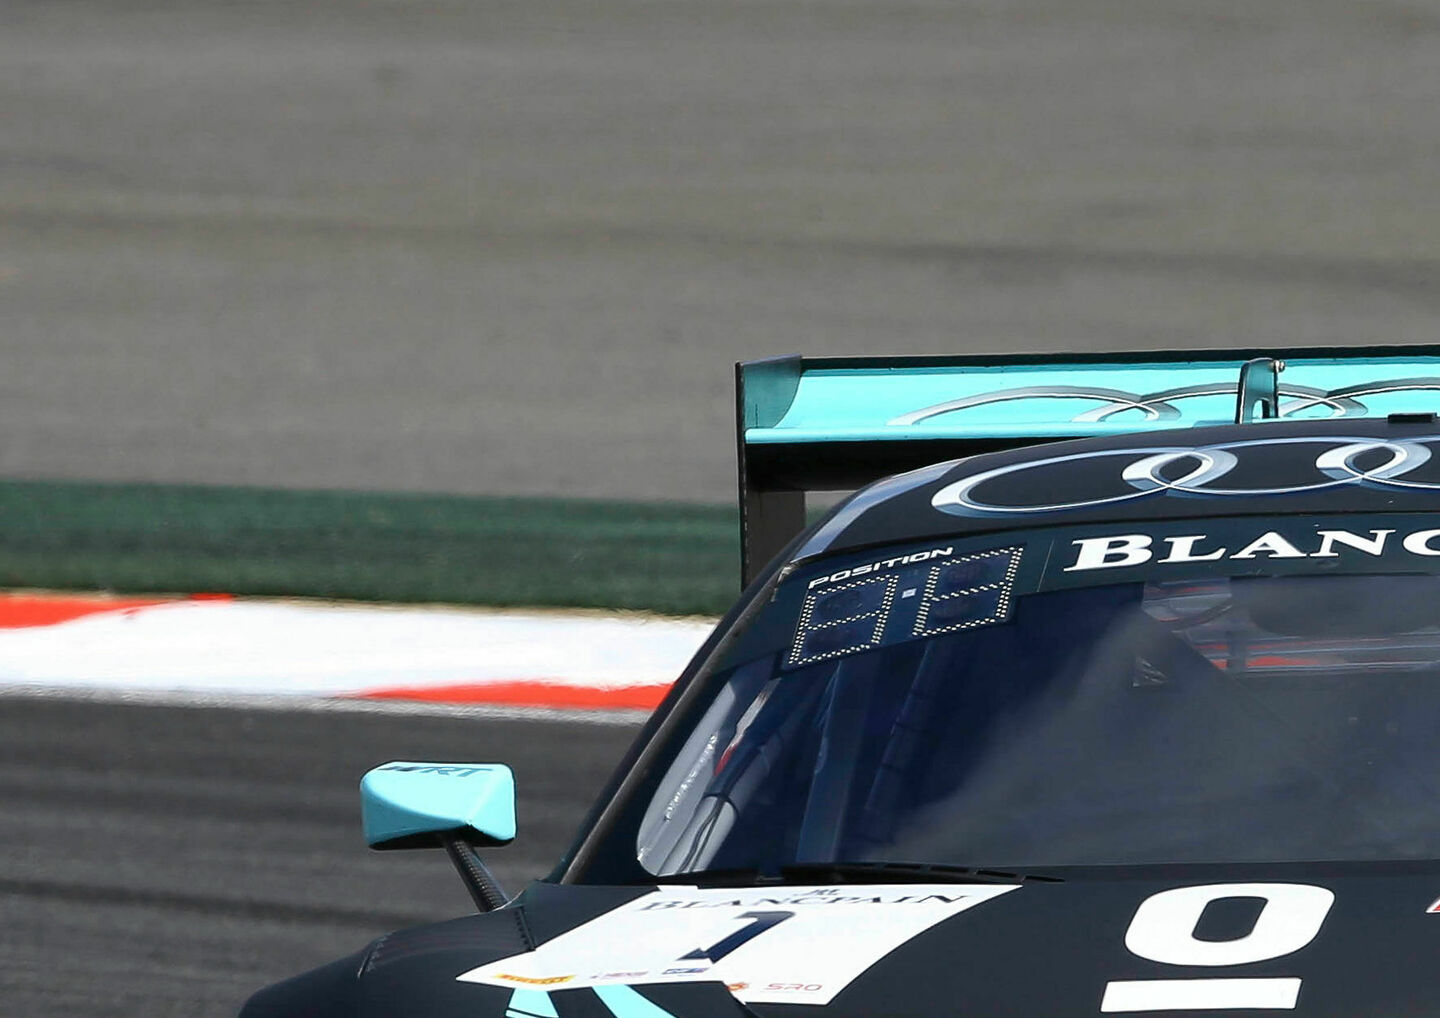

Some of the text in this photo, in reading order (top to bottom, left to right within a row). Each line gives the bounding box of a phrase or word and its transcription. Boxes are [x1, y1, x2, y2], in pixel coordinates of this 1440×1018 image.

[807, 546, 954, 590] POSITION
[641, 894, 968, 911] BLANCPAIN
[675, 911, 797, 965] 1
[763, 982, 823, 992] SRO
